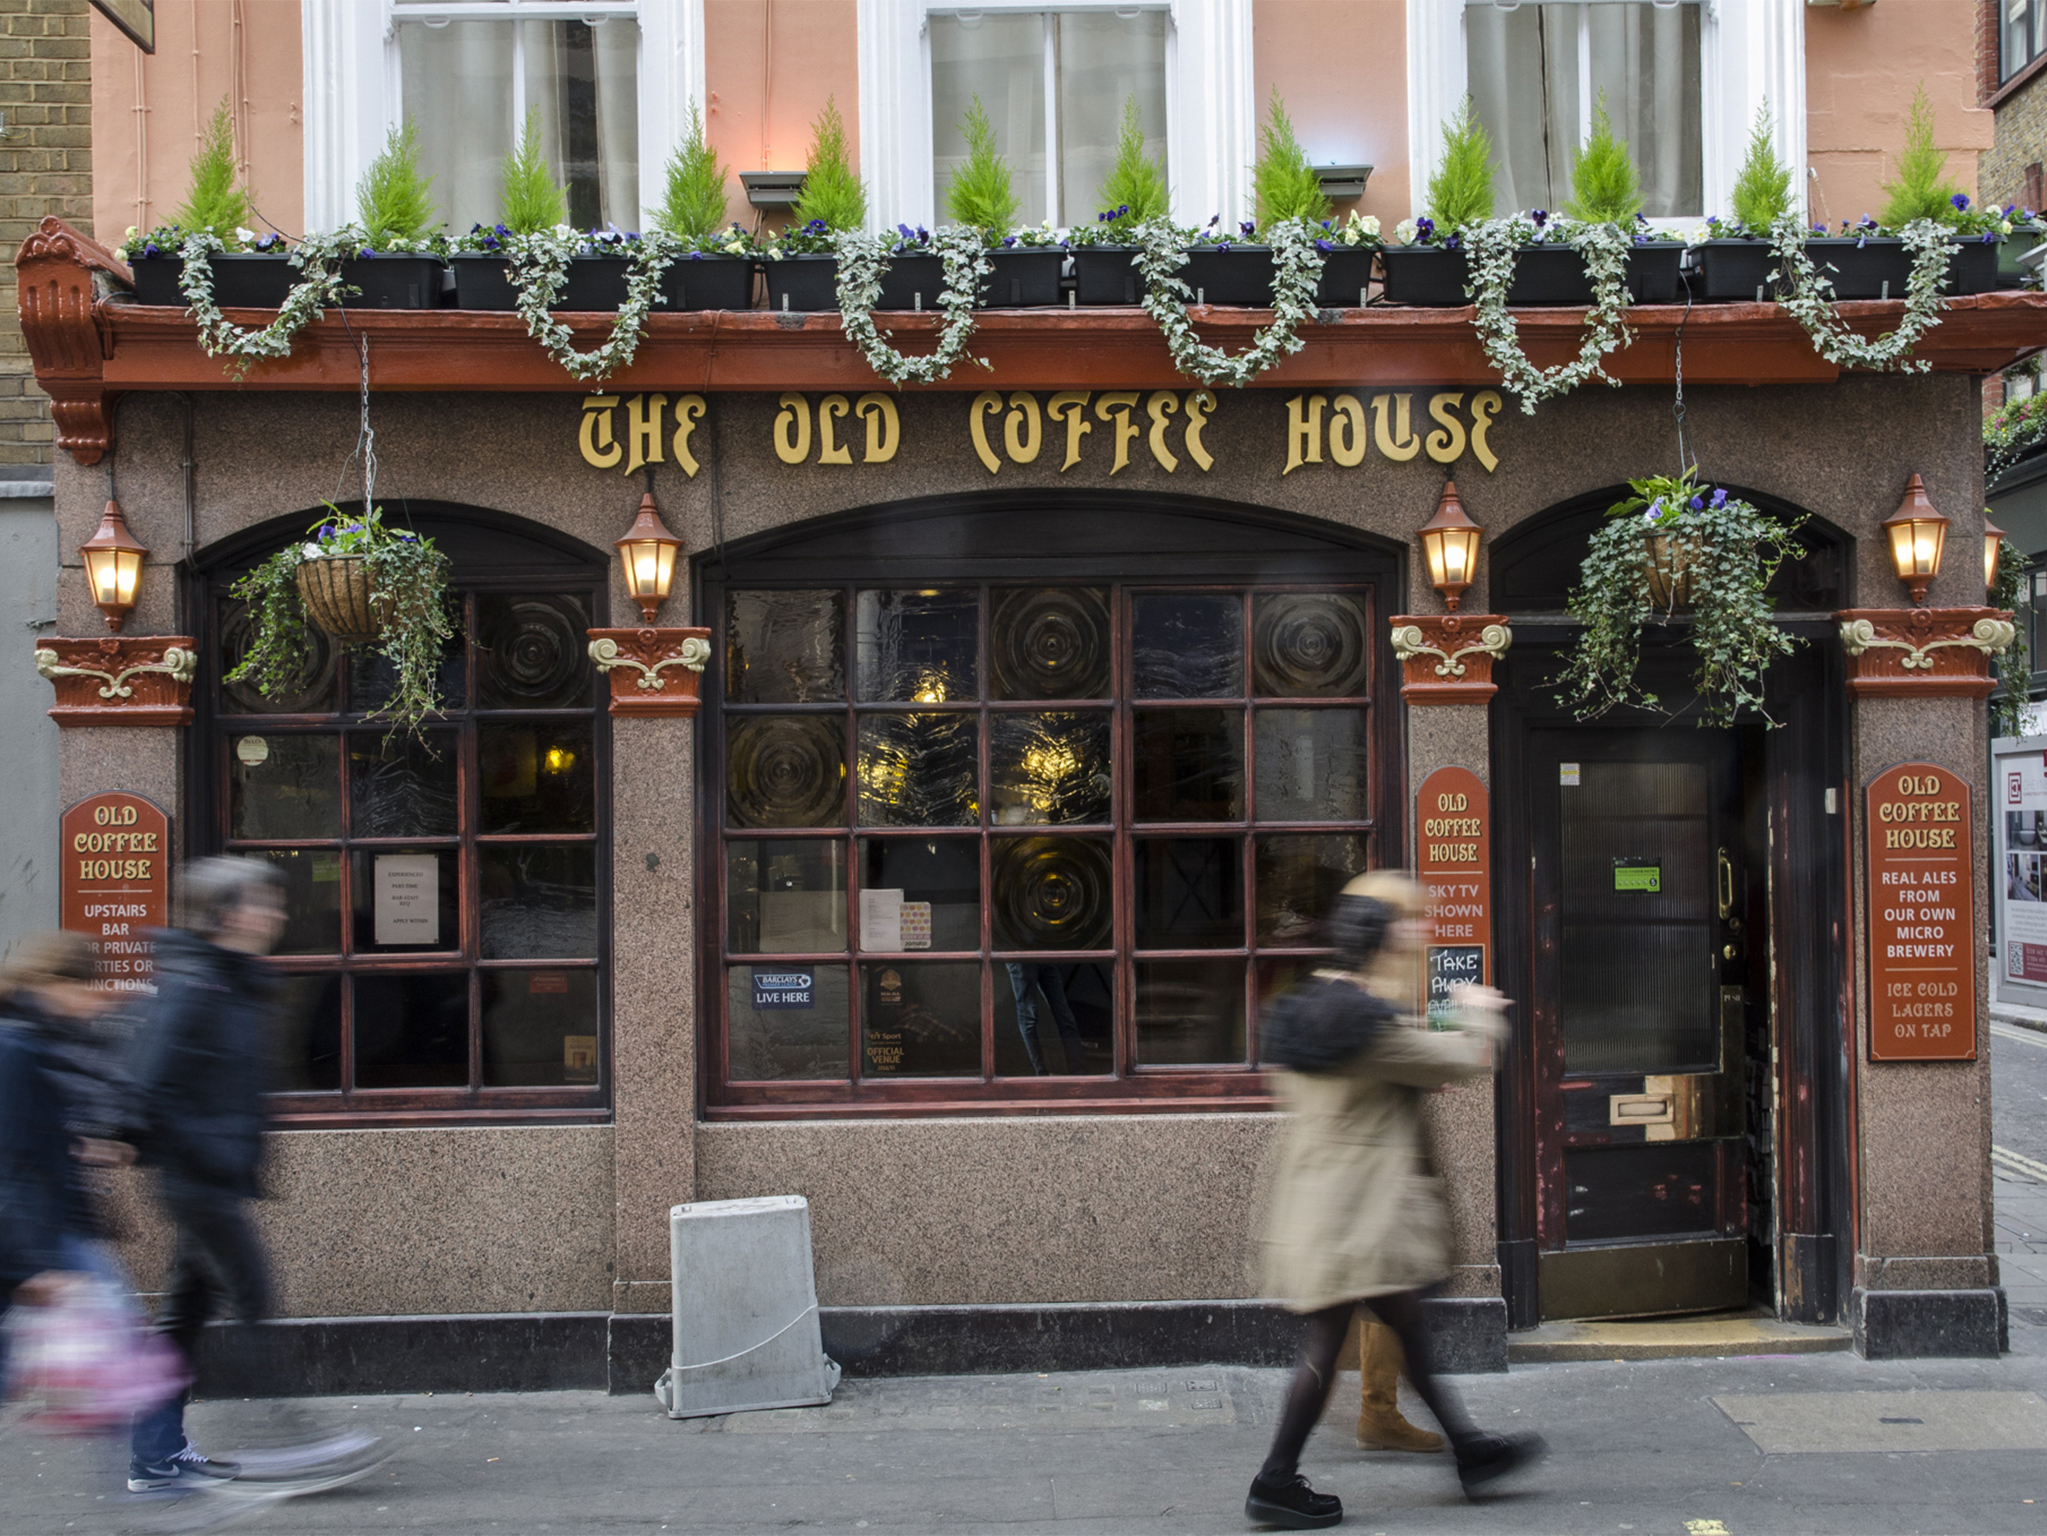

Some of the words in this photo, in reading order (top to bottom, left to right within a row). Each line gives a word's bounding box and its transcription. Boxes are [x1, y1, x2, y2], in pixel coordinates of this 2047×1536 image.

[578, 393, 707, 478] THE
[773, 391, 900, 465] OLD
[969, 390, 1218, 476] COFFEE
[1282, 390, 1503, 476] HOUSE
[1898, 775, 1941, 796] OLD
[1437, 793, 1468, 812] OLD
[94, 805, 138, 826] OLD
[1879, 801, 1961, 822] COFFEE
[1425, 818, 1482, 837] COFFEE
[74, 832, 159, 853] COFFEE
[1885, 828, 1956, 849] HOUSE
[1429, 843, 1478, 862] HOUSE
[79, 859, 153, 880] HOUSE
[1651, 878, 1656, 886] 5
[1882, 872, 1918, 885] REAL
[1922, 871, 1957, 884] ALES
[1428, 884, 1455, 898] SKY
[1459, 884, 1479, 898] TV
[1899, 890, 1940, 903] FROM
[84, 904, 147, 918] UPSTAIRS
[1424, 904, 1483, 918] SHOWN
[1884, 908, 1915, 921] OUR
[1920, 908, 1956, 921] OWN
[102, 923, 129, 936] BAR
[1434, 924, 1474, 937] HERE
[1896, 926, 1944, 939] MICRO
[104, 941, 157, 954] PRIVATE
[1886, 944, 1954, 958] BREWERY
[88, 960, 130, 973] RTIES
[133, 959, 154, 972] OR
[1430, 949, 1478, 972] TAKE
[83, 978, 156, 992] UNCTIONS
[1431, 975, 1478, 994] AWAY
[1887, 983, 1912, 997] ICE
[1917, 982, 1958, 997] COLD
[756, 992, 780, 1003] LIVE
[782, 992, 810, 1003] HERE
[1892, 1003, 1954, 1018] LAGERS
[882, 1033, 901, 1041] Sport
[1894, 1024, 1916, 1038] ON
[1921, 1024, 1952, 1038] TAP
[867, 1047, 905, 1056] OFFICIAL
[872, 1055, 901, 1064] VENUE
